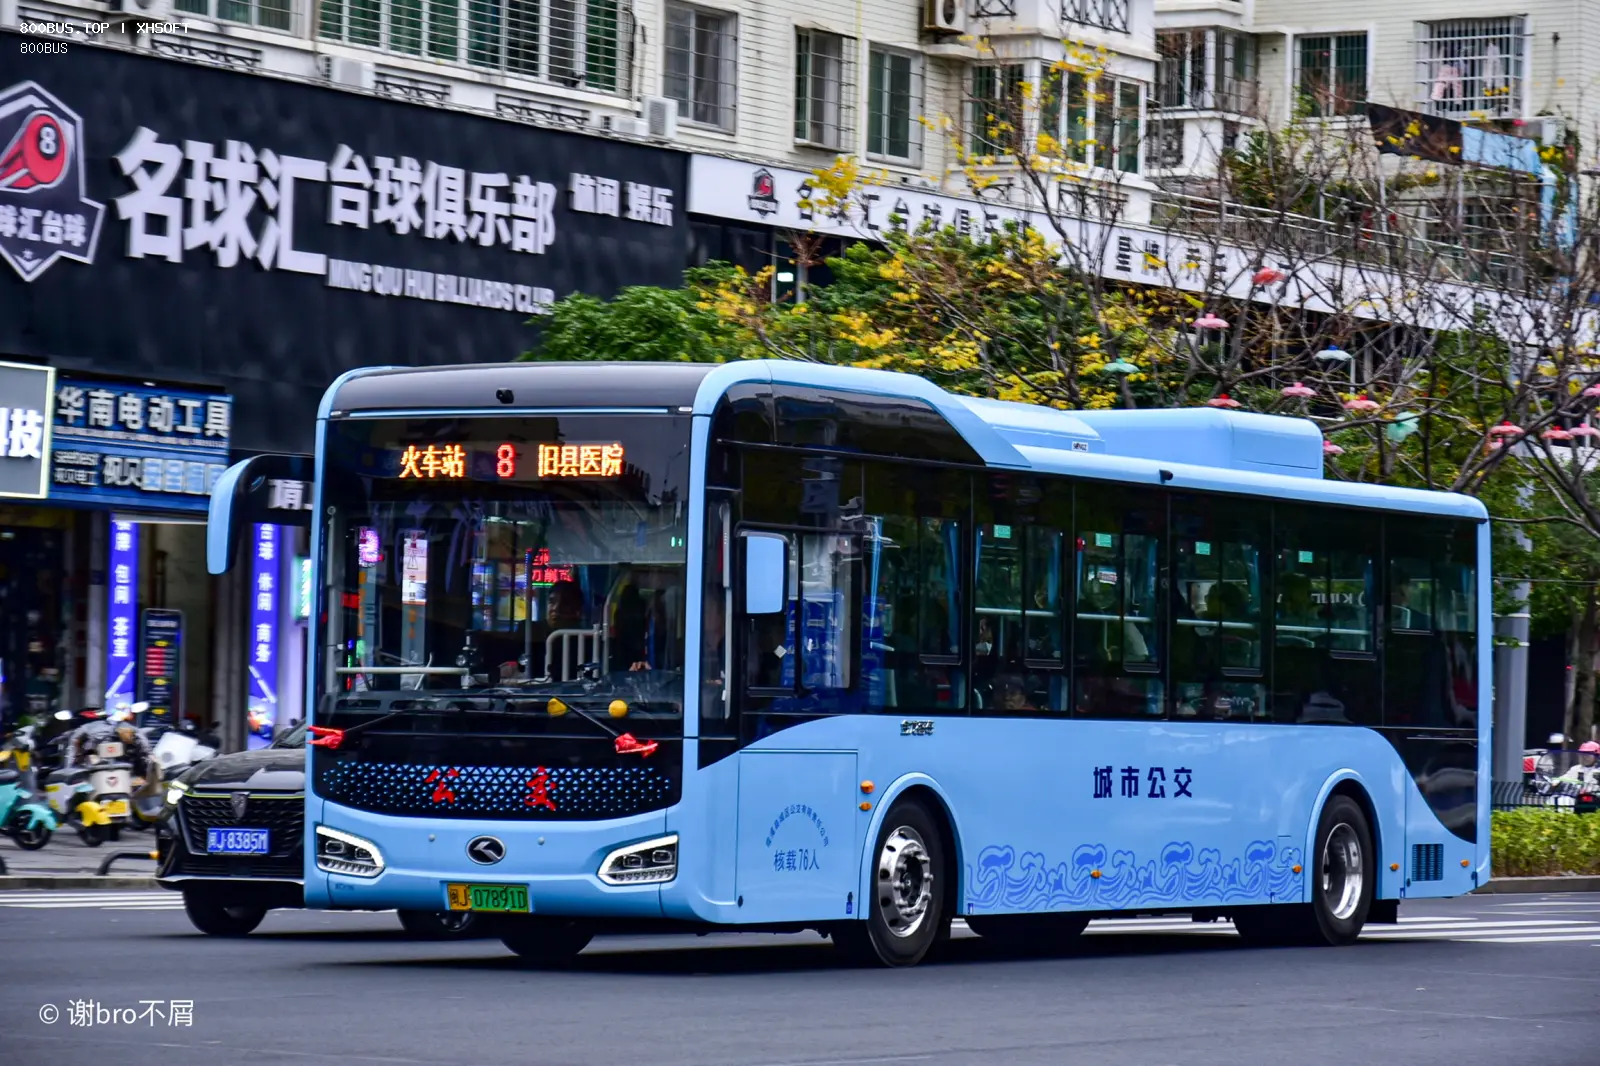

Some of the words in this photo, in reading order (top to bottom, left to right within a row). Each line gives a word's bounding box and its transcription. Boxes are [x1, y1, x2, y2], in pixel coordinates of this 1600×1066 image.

[40, 126, 57, 155] 8
[114, 126, 327, 275] 名球汇
[328, 143, 558, 255] 台球俱乐部
[623, 180, 674, 227] 娱乐
[328, 258, 372, 292] MING
[372, 264, 404, 297] QIU
[404, 269, 435, 300] HUI
[435, 273, 515, 312] BILLIARDS
[514, 283, 555, 316] CLUB
[56, 386, 231, 438] 华南电动工具
[398, 443, 465, 479] 火车站
[496, 443, 516, 479] 8
[1092, 765, 1193, 799] 城市公交
[773, 848, 820, 872] 核载76人
